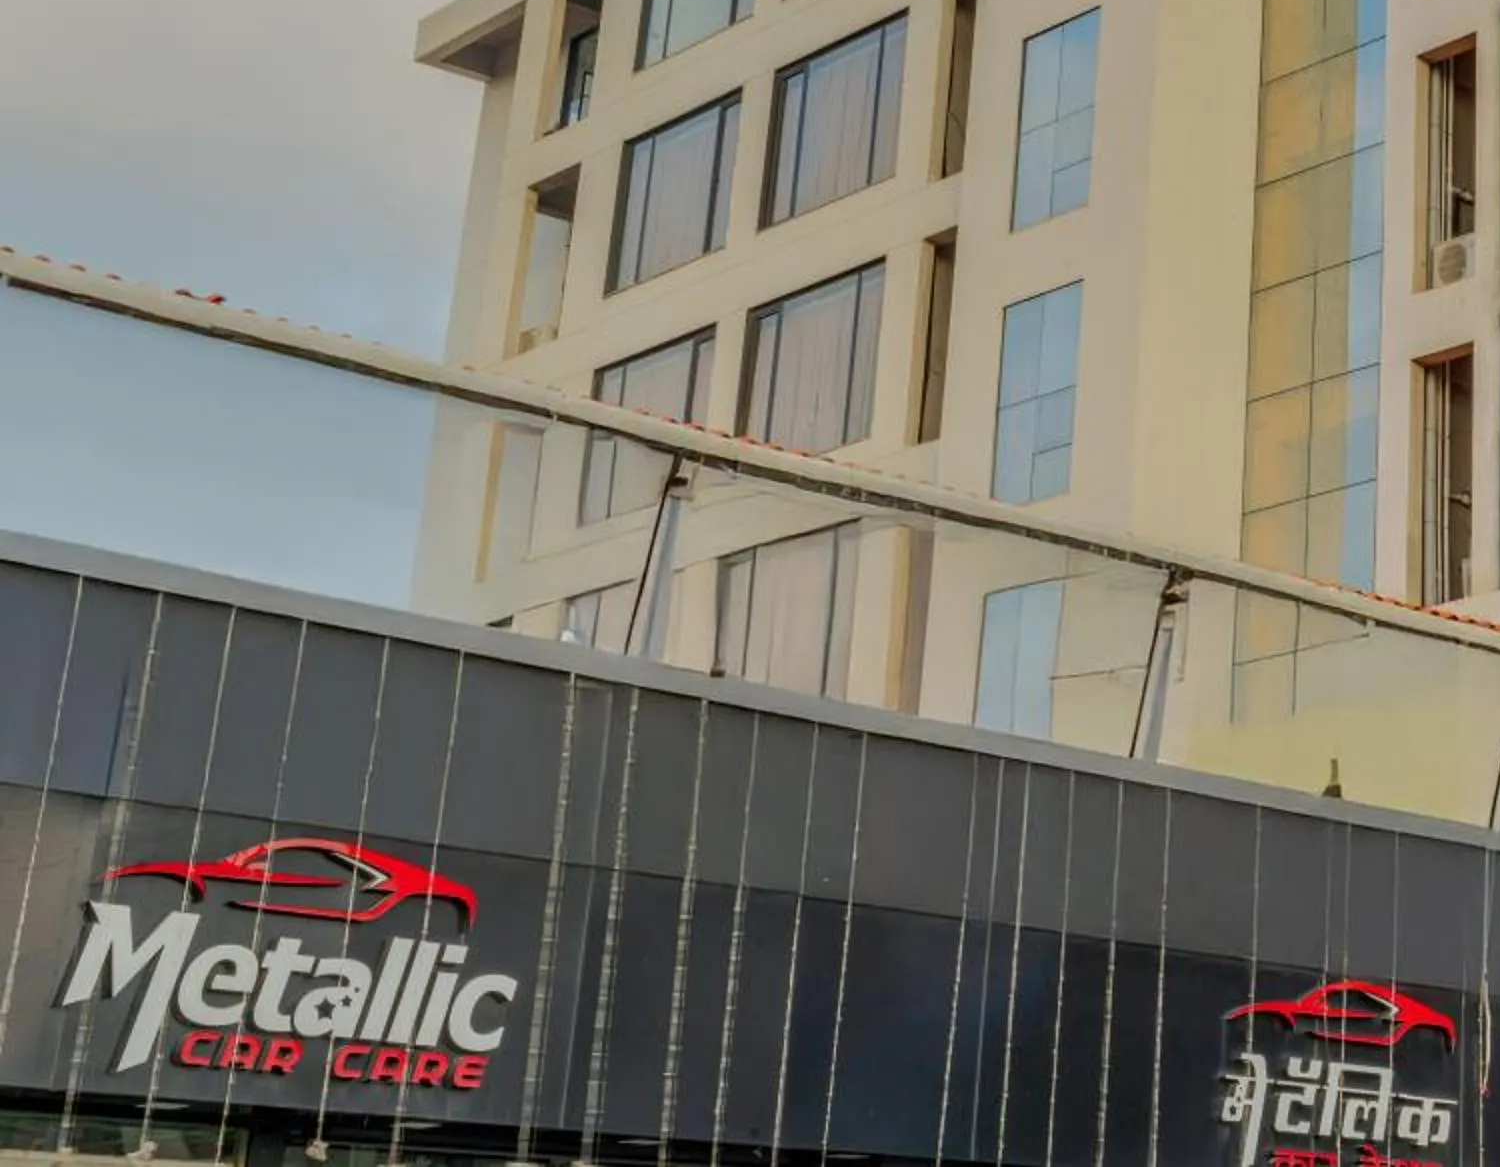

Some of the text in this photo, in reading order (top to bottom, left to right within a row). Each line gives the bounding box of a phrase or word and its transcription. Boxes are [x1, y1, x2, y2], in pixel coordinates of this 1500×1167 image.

[62, 900, 519, 1072] Metallic
[179, 1030, 491, 1089] CAR CARE
